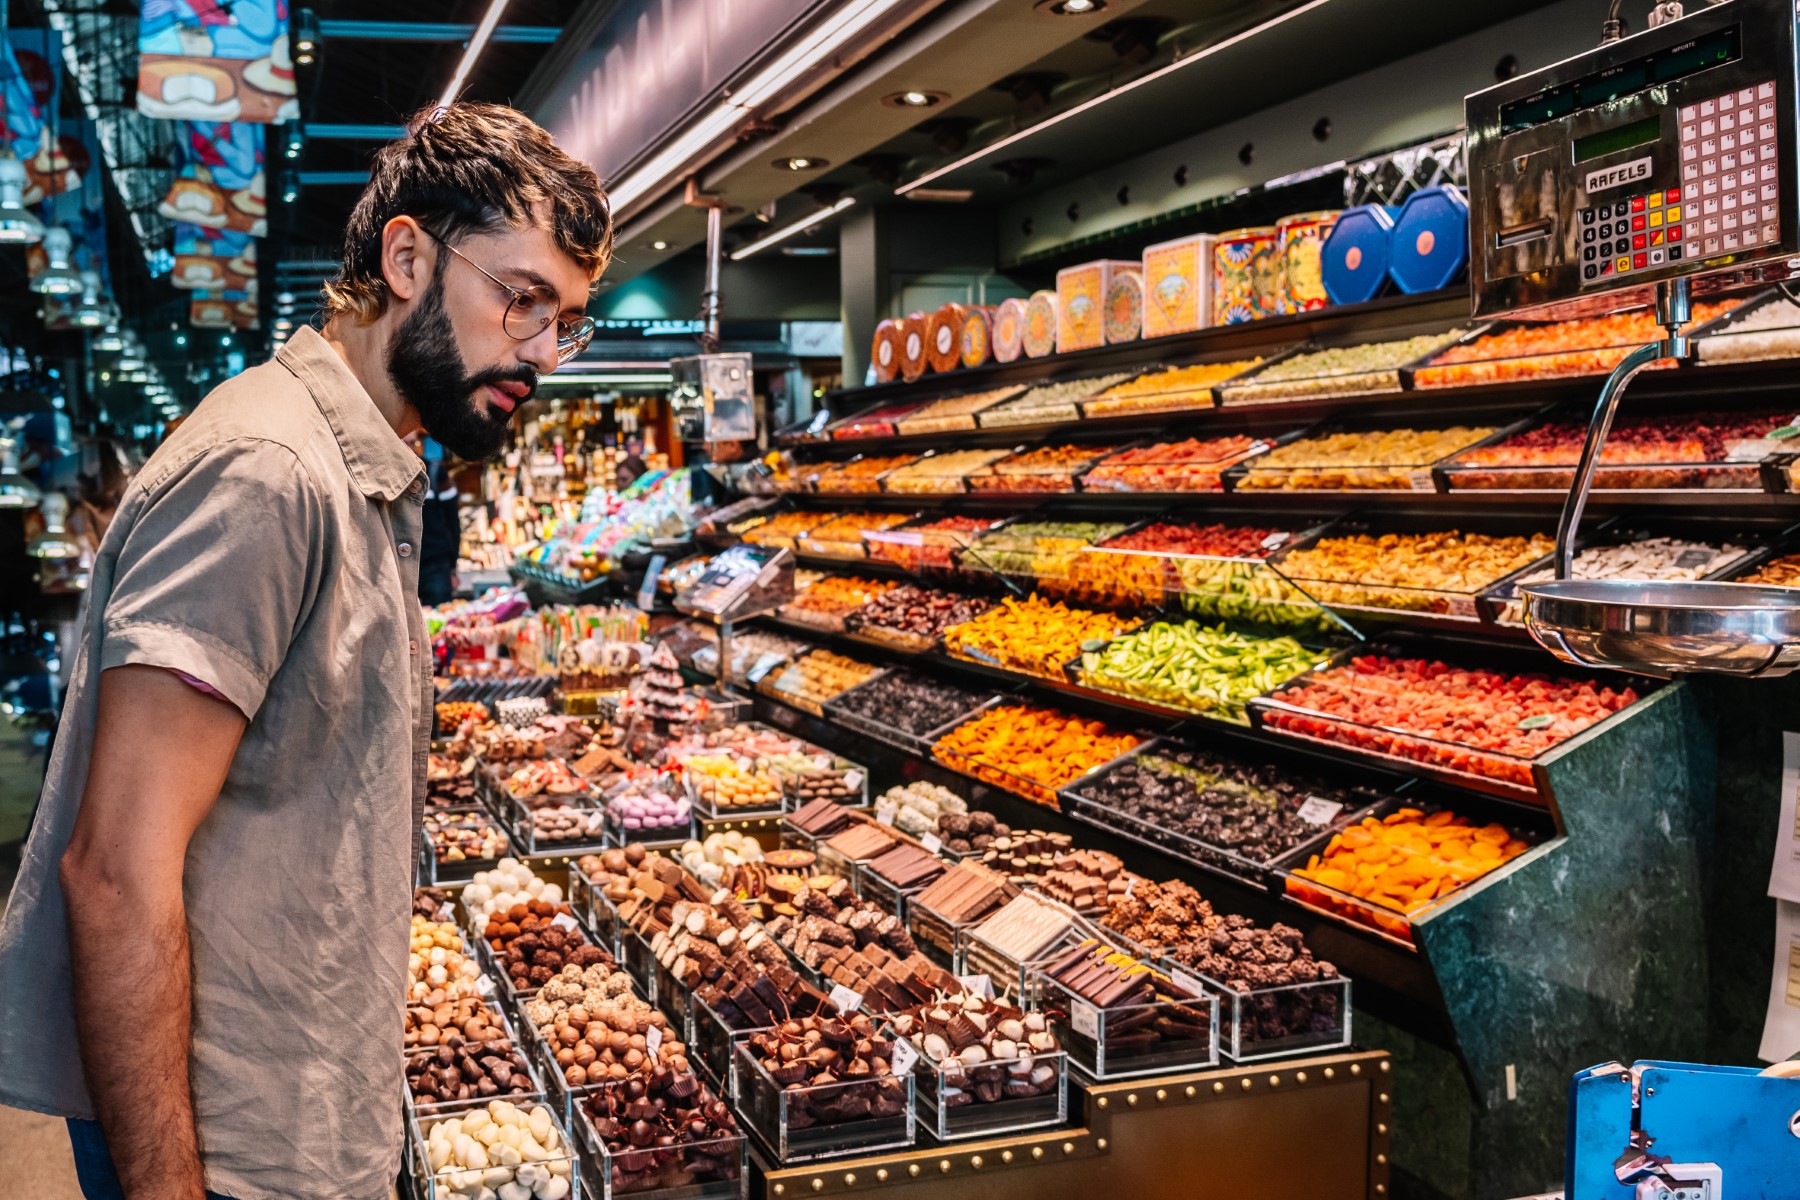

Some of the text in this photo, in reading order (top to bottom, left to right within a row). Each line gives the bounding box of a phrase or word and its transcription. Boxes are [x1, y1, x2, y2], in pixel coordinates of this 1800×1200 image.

[1672, 41, 1696, 54] IMPORTE
[1601, 69, 1615, 78] PESO
[1527, 95, 1543, 103] PRECIO
[1590, 164, 1646, 189] RAFELS
[1586, 213, 1592, 222] 7
[1602, 209, 1608, 218] 8
[1587, 224, 1625, 240] 4 5 6
[1589, 250, 1592, 258] 1
[1603, 246, 1610, 255] 2
